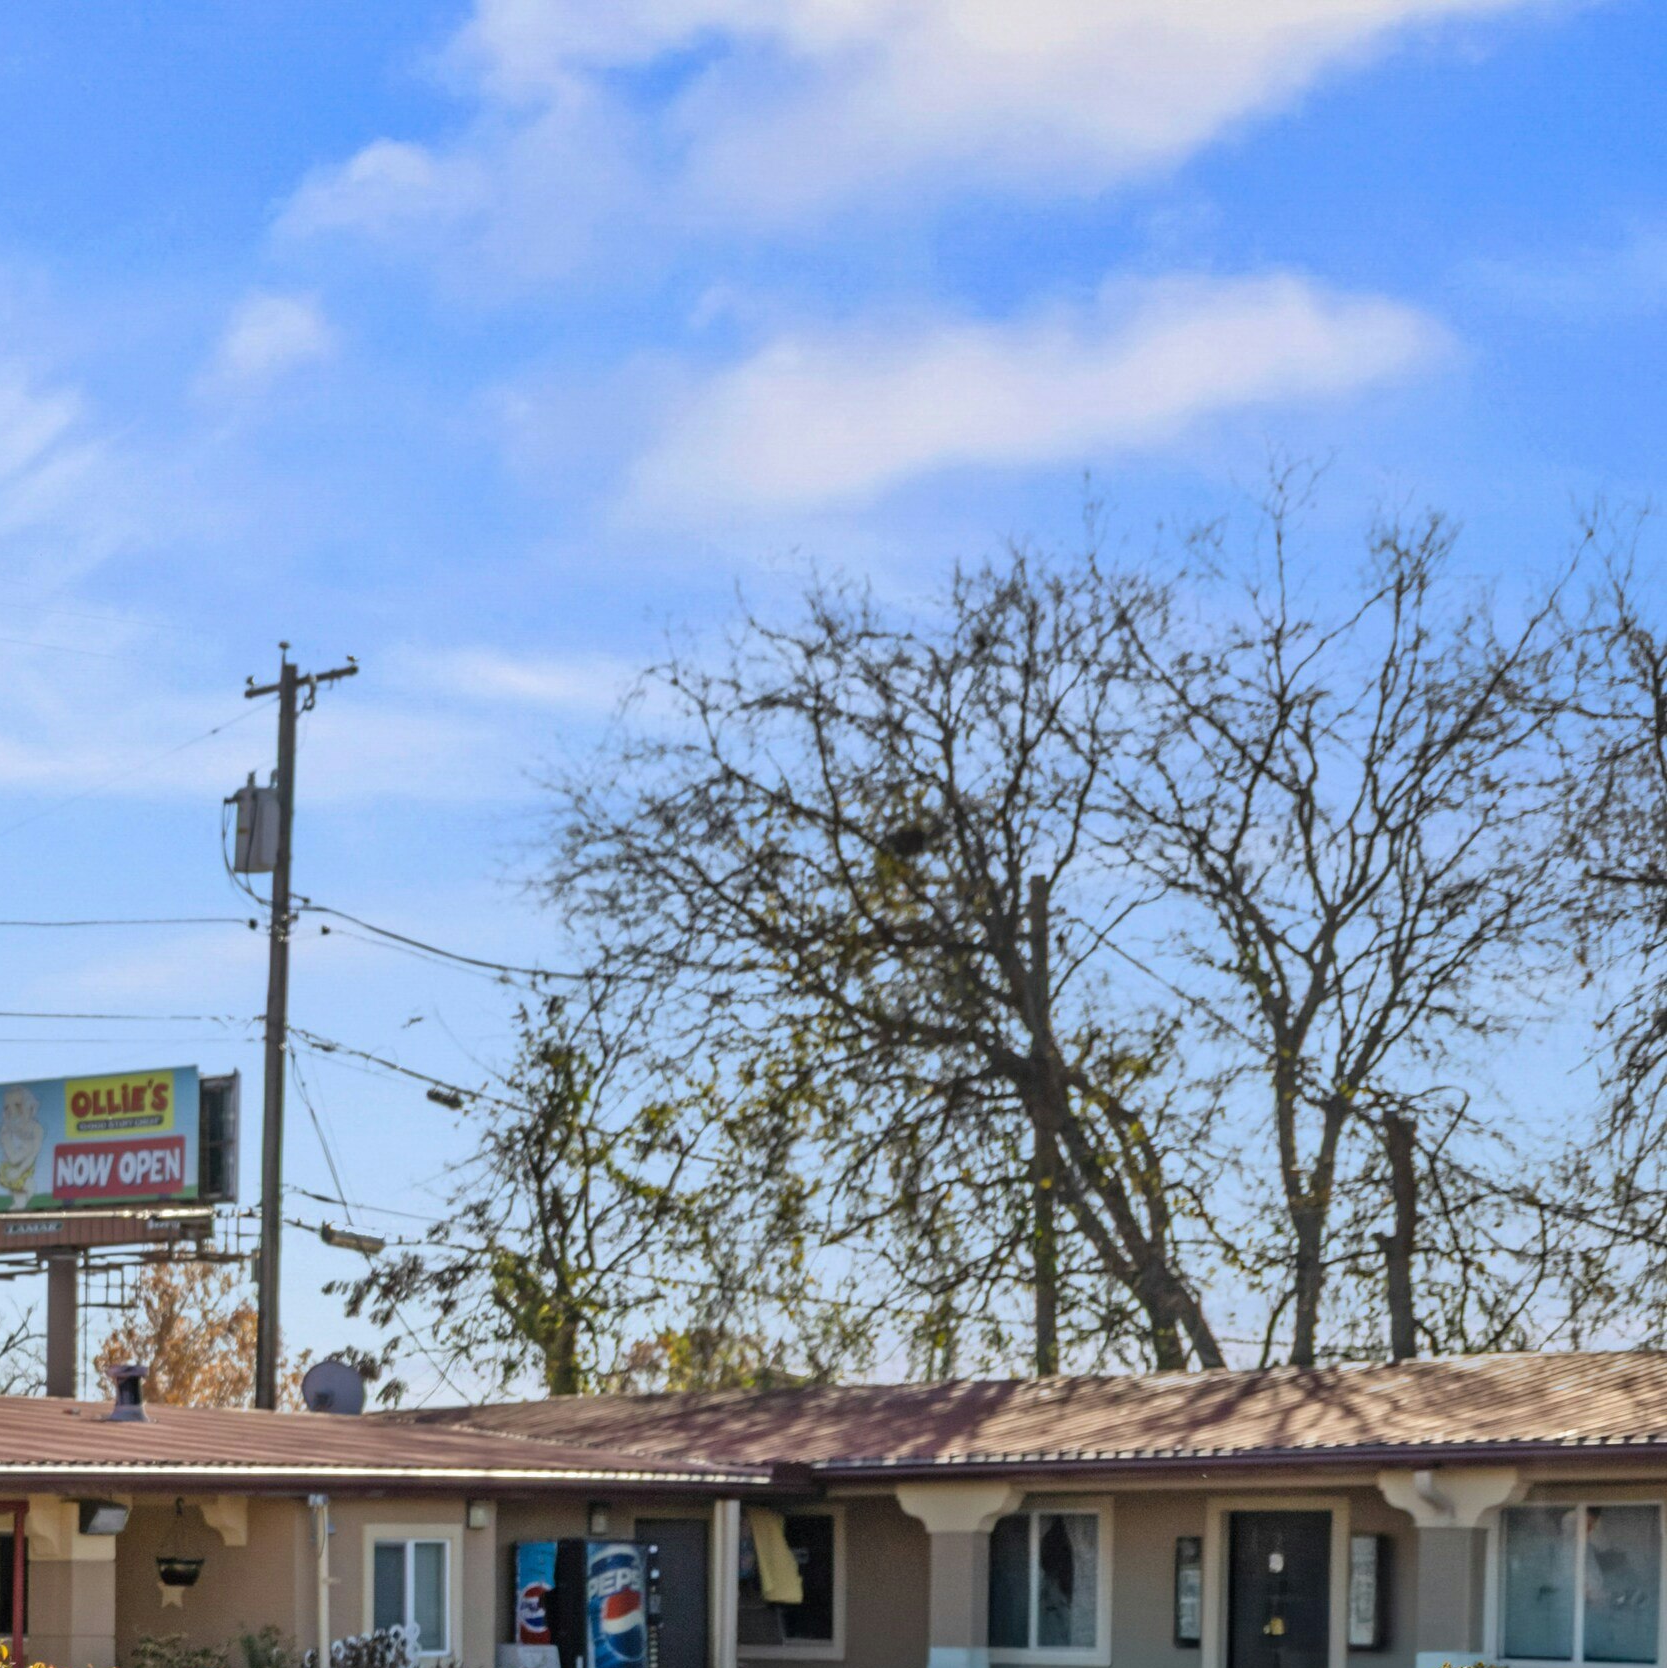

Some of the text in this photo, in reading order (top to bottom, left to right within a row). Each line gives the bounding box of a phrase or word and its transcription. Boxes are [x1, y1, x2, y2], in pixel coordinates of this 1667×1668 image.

[71, 1078, 169, 1118] OLLIE'S
[56, 1146, 181, 1188] NOW OPEN
[587, 1567, 644, 1600] PEPS
